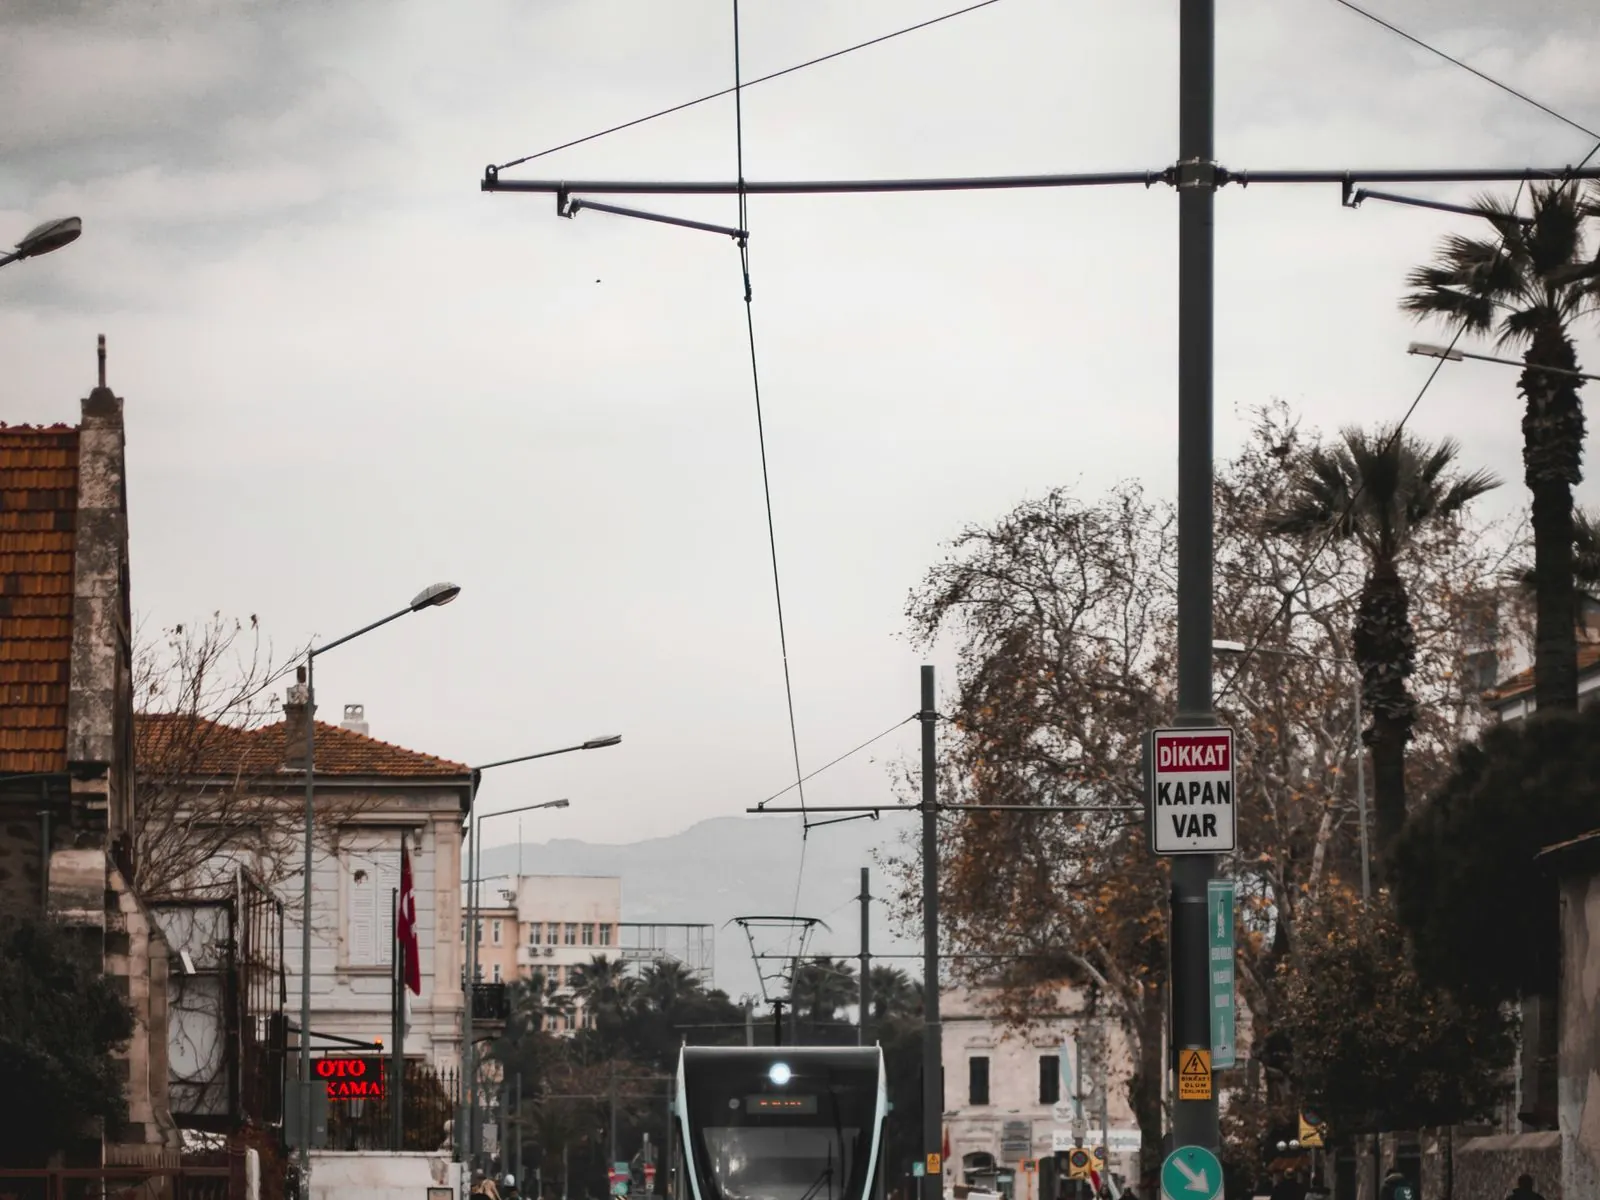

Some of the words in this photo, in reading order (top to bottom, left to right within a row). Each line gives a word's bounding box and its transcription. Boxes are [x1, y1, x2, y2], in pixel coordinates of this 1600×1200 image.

[1160, 740, 1226, 766] DİKKAT
[1157, 781, 1230, 805] KAPAN
[1171, 813, 1217, 837] VAR
[316, 1059, 366, 1077] OTO
[327, 1081, 381, 1096] KAMA
